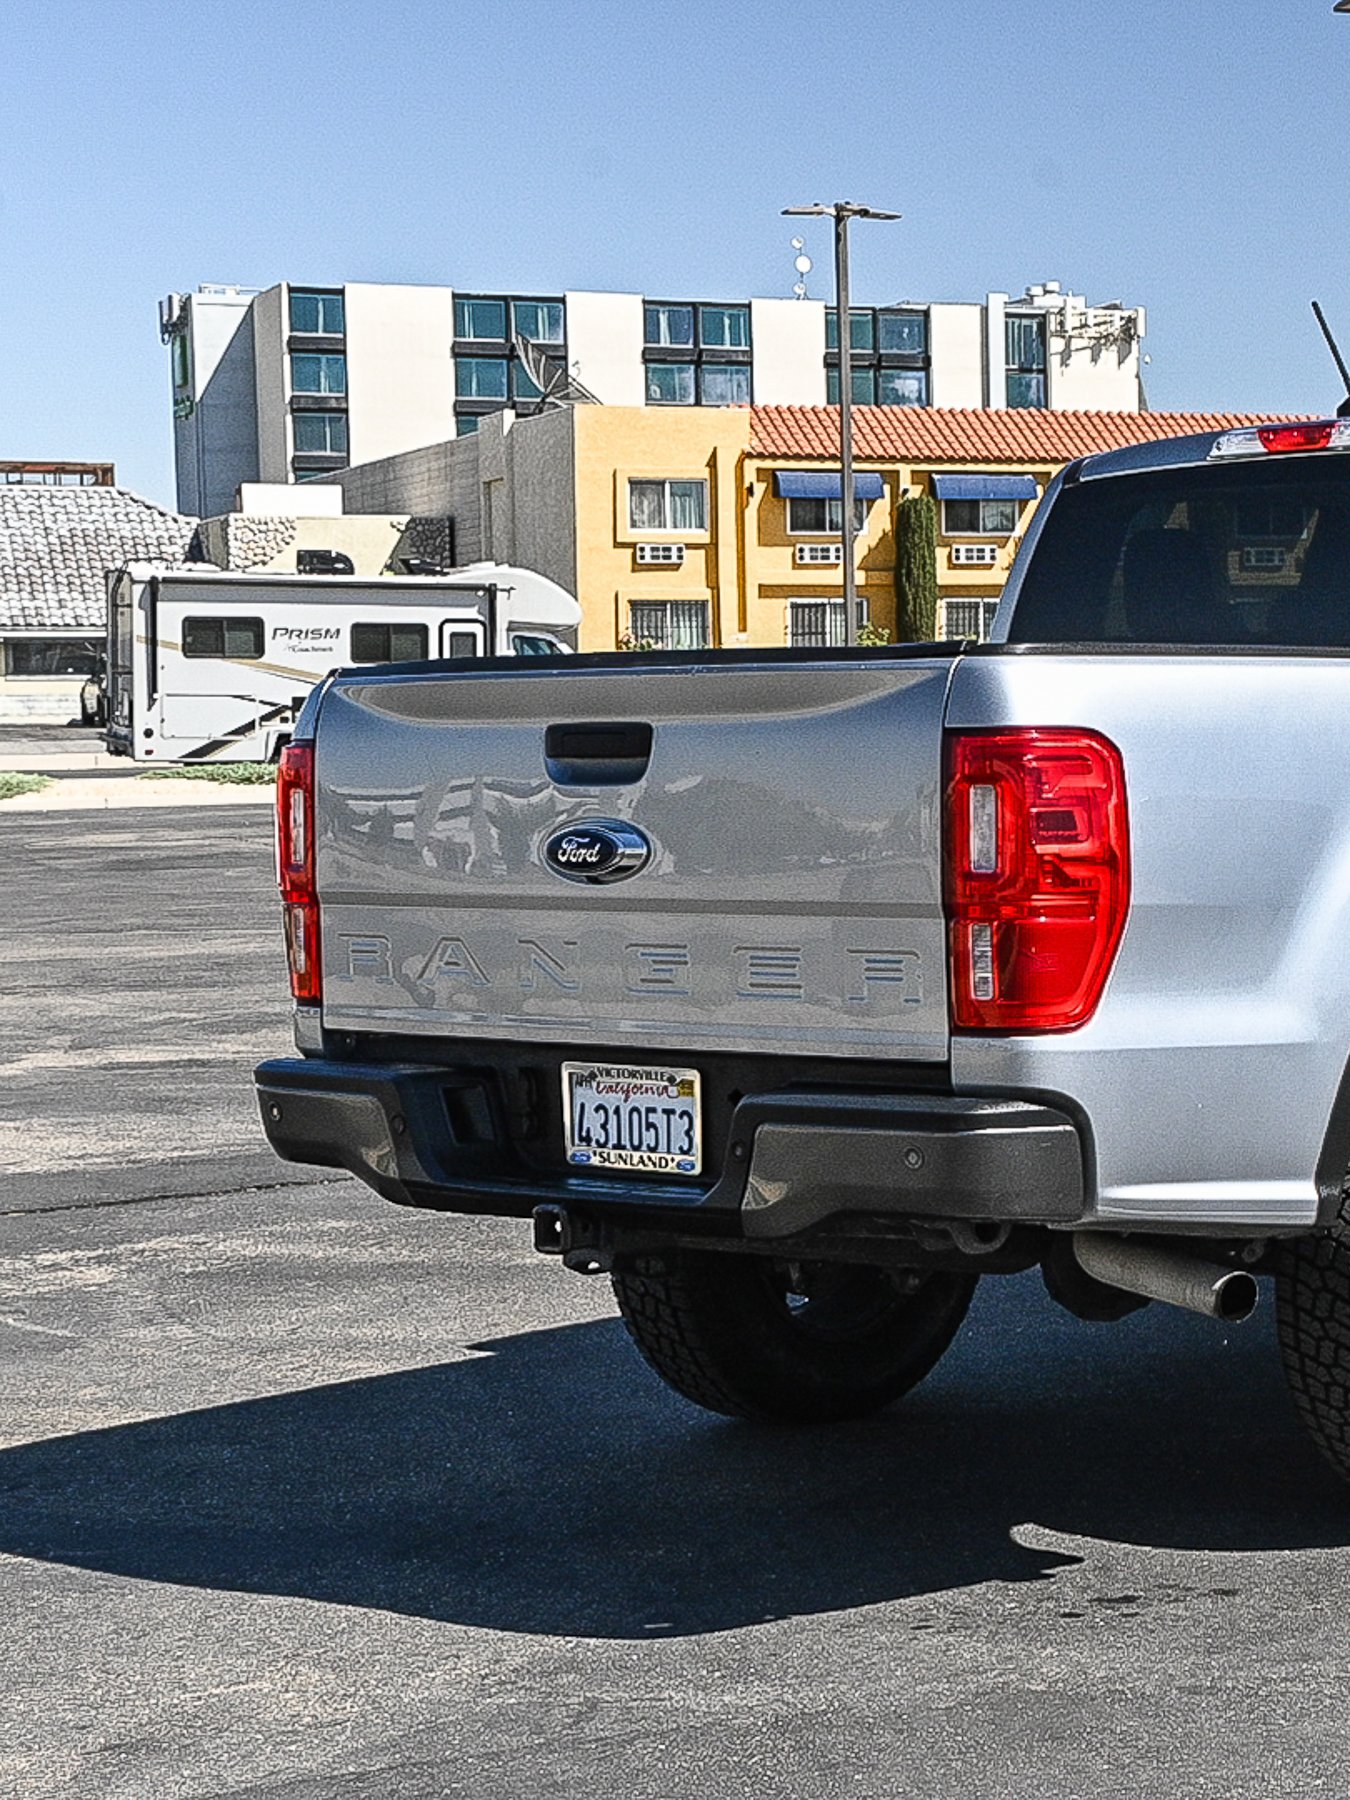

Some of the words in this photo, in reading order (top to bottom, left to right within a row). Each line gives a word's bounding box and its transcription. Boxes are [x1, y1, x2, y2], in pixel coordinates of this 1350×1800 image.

[271, 627, 341, 641] PRISM
[557, 836, 601, 863] Ford
[337, 932, 922, 1003] RANGER
[597, 1066, 667, 1082] VICTORVILLE
[577, 1101, 694, 1156] 43105T3
[600, 1151, 670, 1170] SUNLAND
